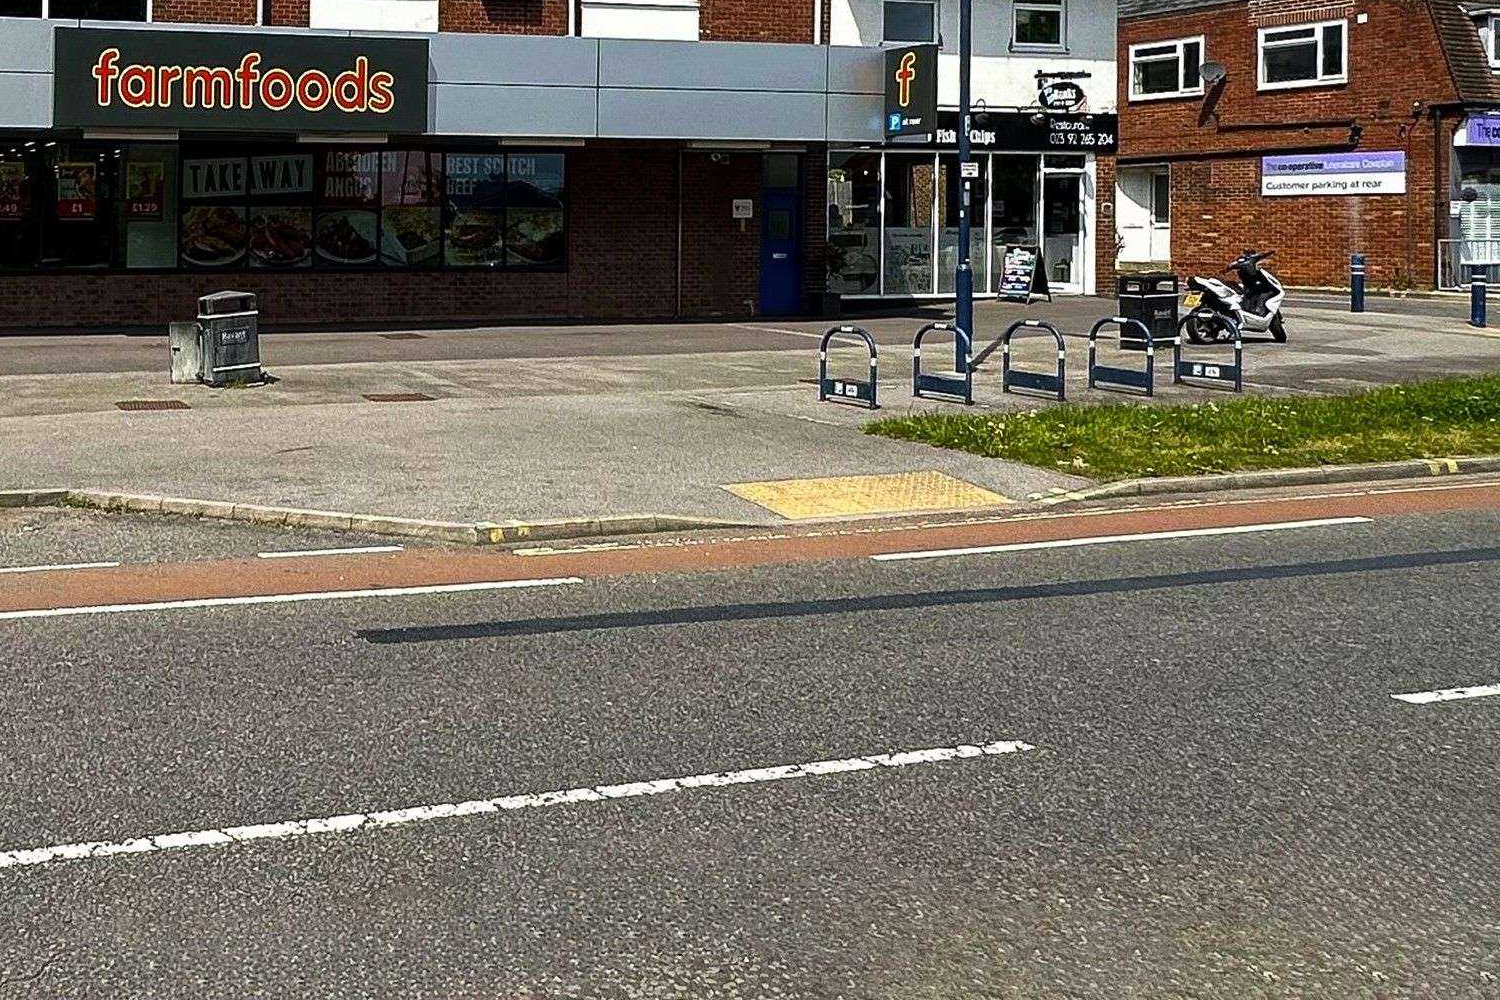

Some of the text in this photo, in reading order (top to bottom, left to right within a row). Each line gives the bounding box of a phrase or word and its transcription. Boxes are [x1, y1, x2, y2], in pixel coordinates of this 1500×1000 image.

[92, 48, 395, 114] farmfoods
[895, 52, 917, 107] f
[936, 129, 957, 143] Fish
[969, 129, 996, 145] Chips
[1049, 133, 1065, 144] 023
[1067, 133, 1077, 144] 92
[1097, 133, 1114, 145] 204
[445, 156, 478, 175] BEST
[1265, 180, 1382, 190] Customer parking at rear
